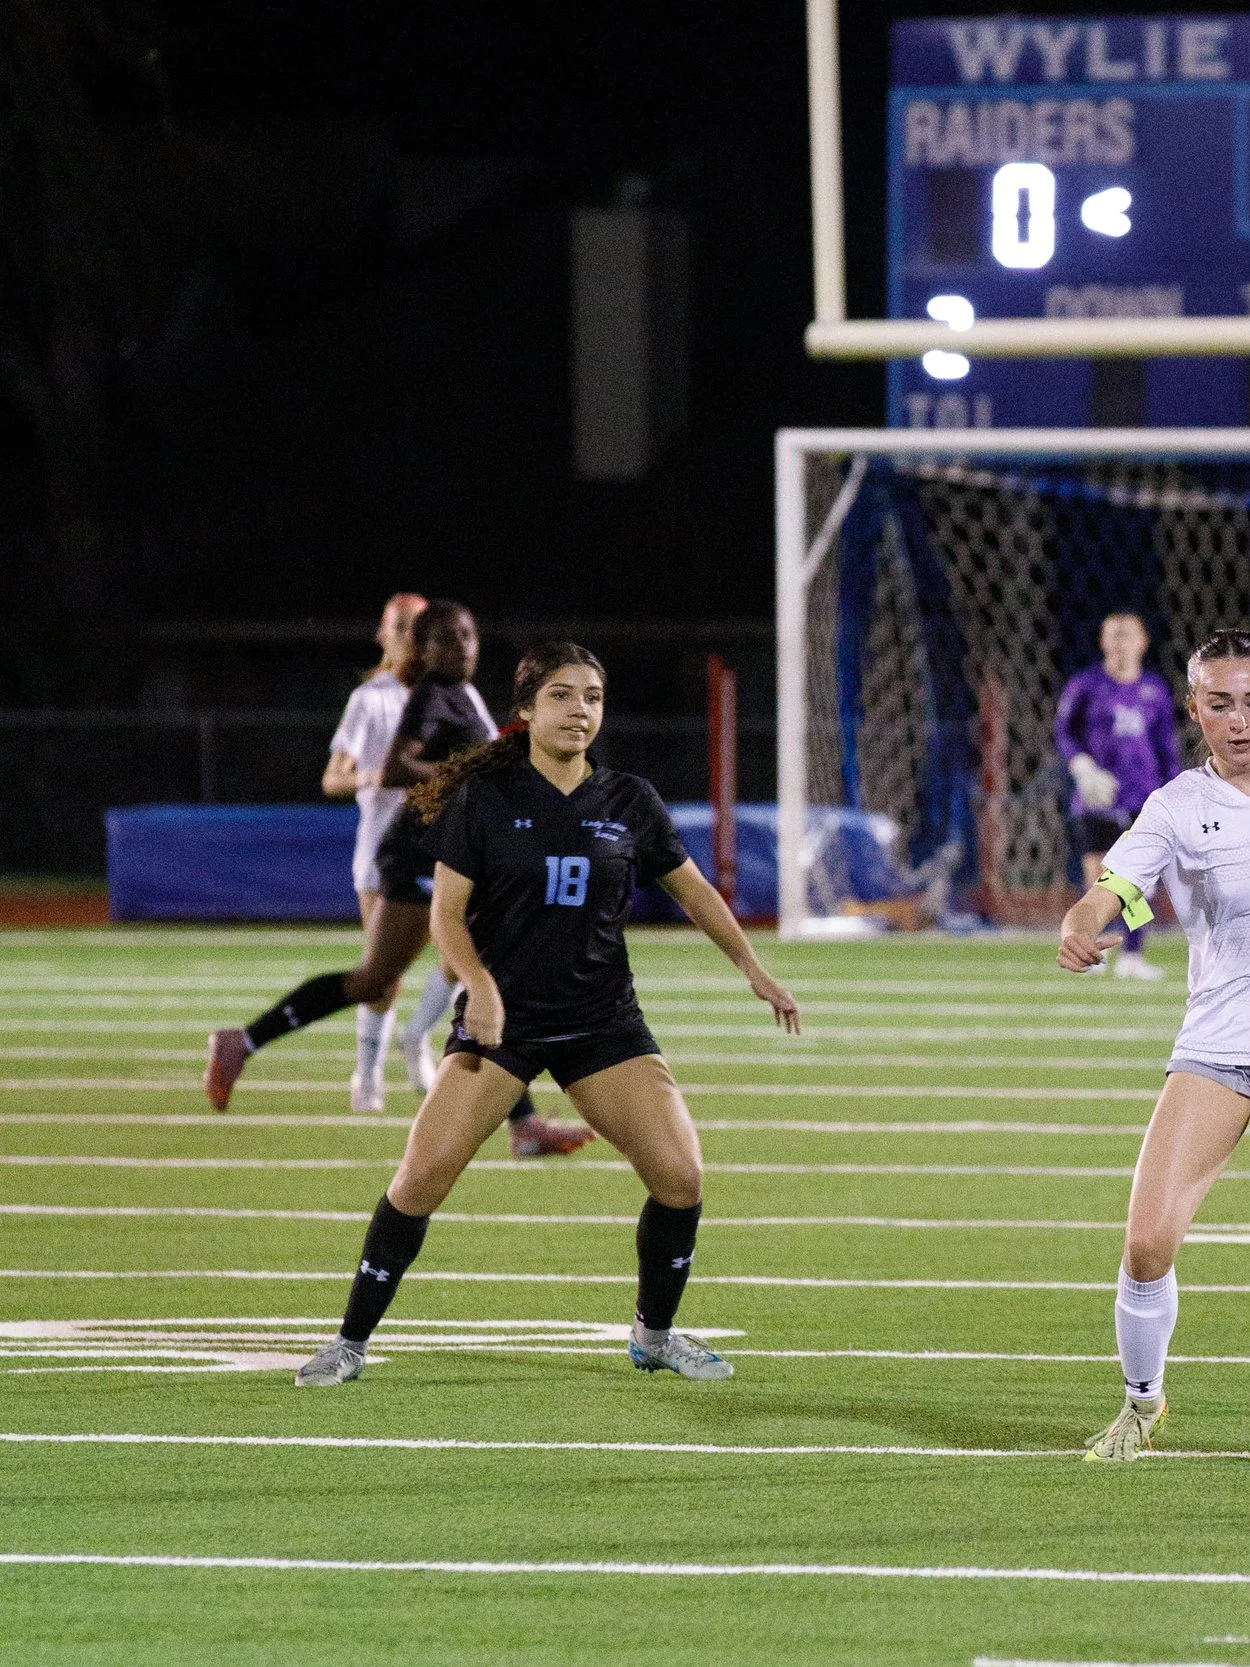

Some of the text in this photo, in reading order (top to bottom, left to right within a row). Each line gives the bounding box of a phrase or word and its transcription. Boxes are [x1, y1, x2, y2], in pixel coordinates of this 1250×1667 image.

[949, 21, 1230, 82] WYLIE
[904, 98, 1136, 167] RAIDERS
[992, 162, 1055, 269] 0
[545, 855, 591, 907] 18
